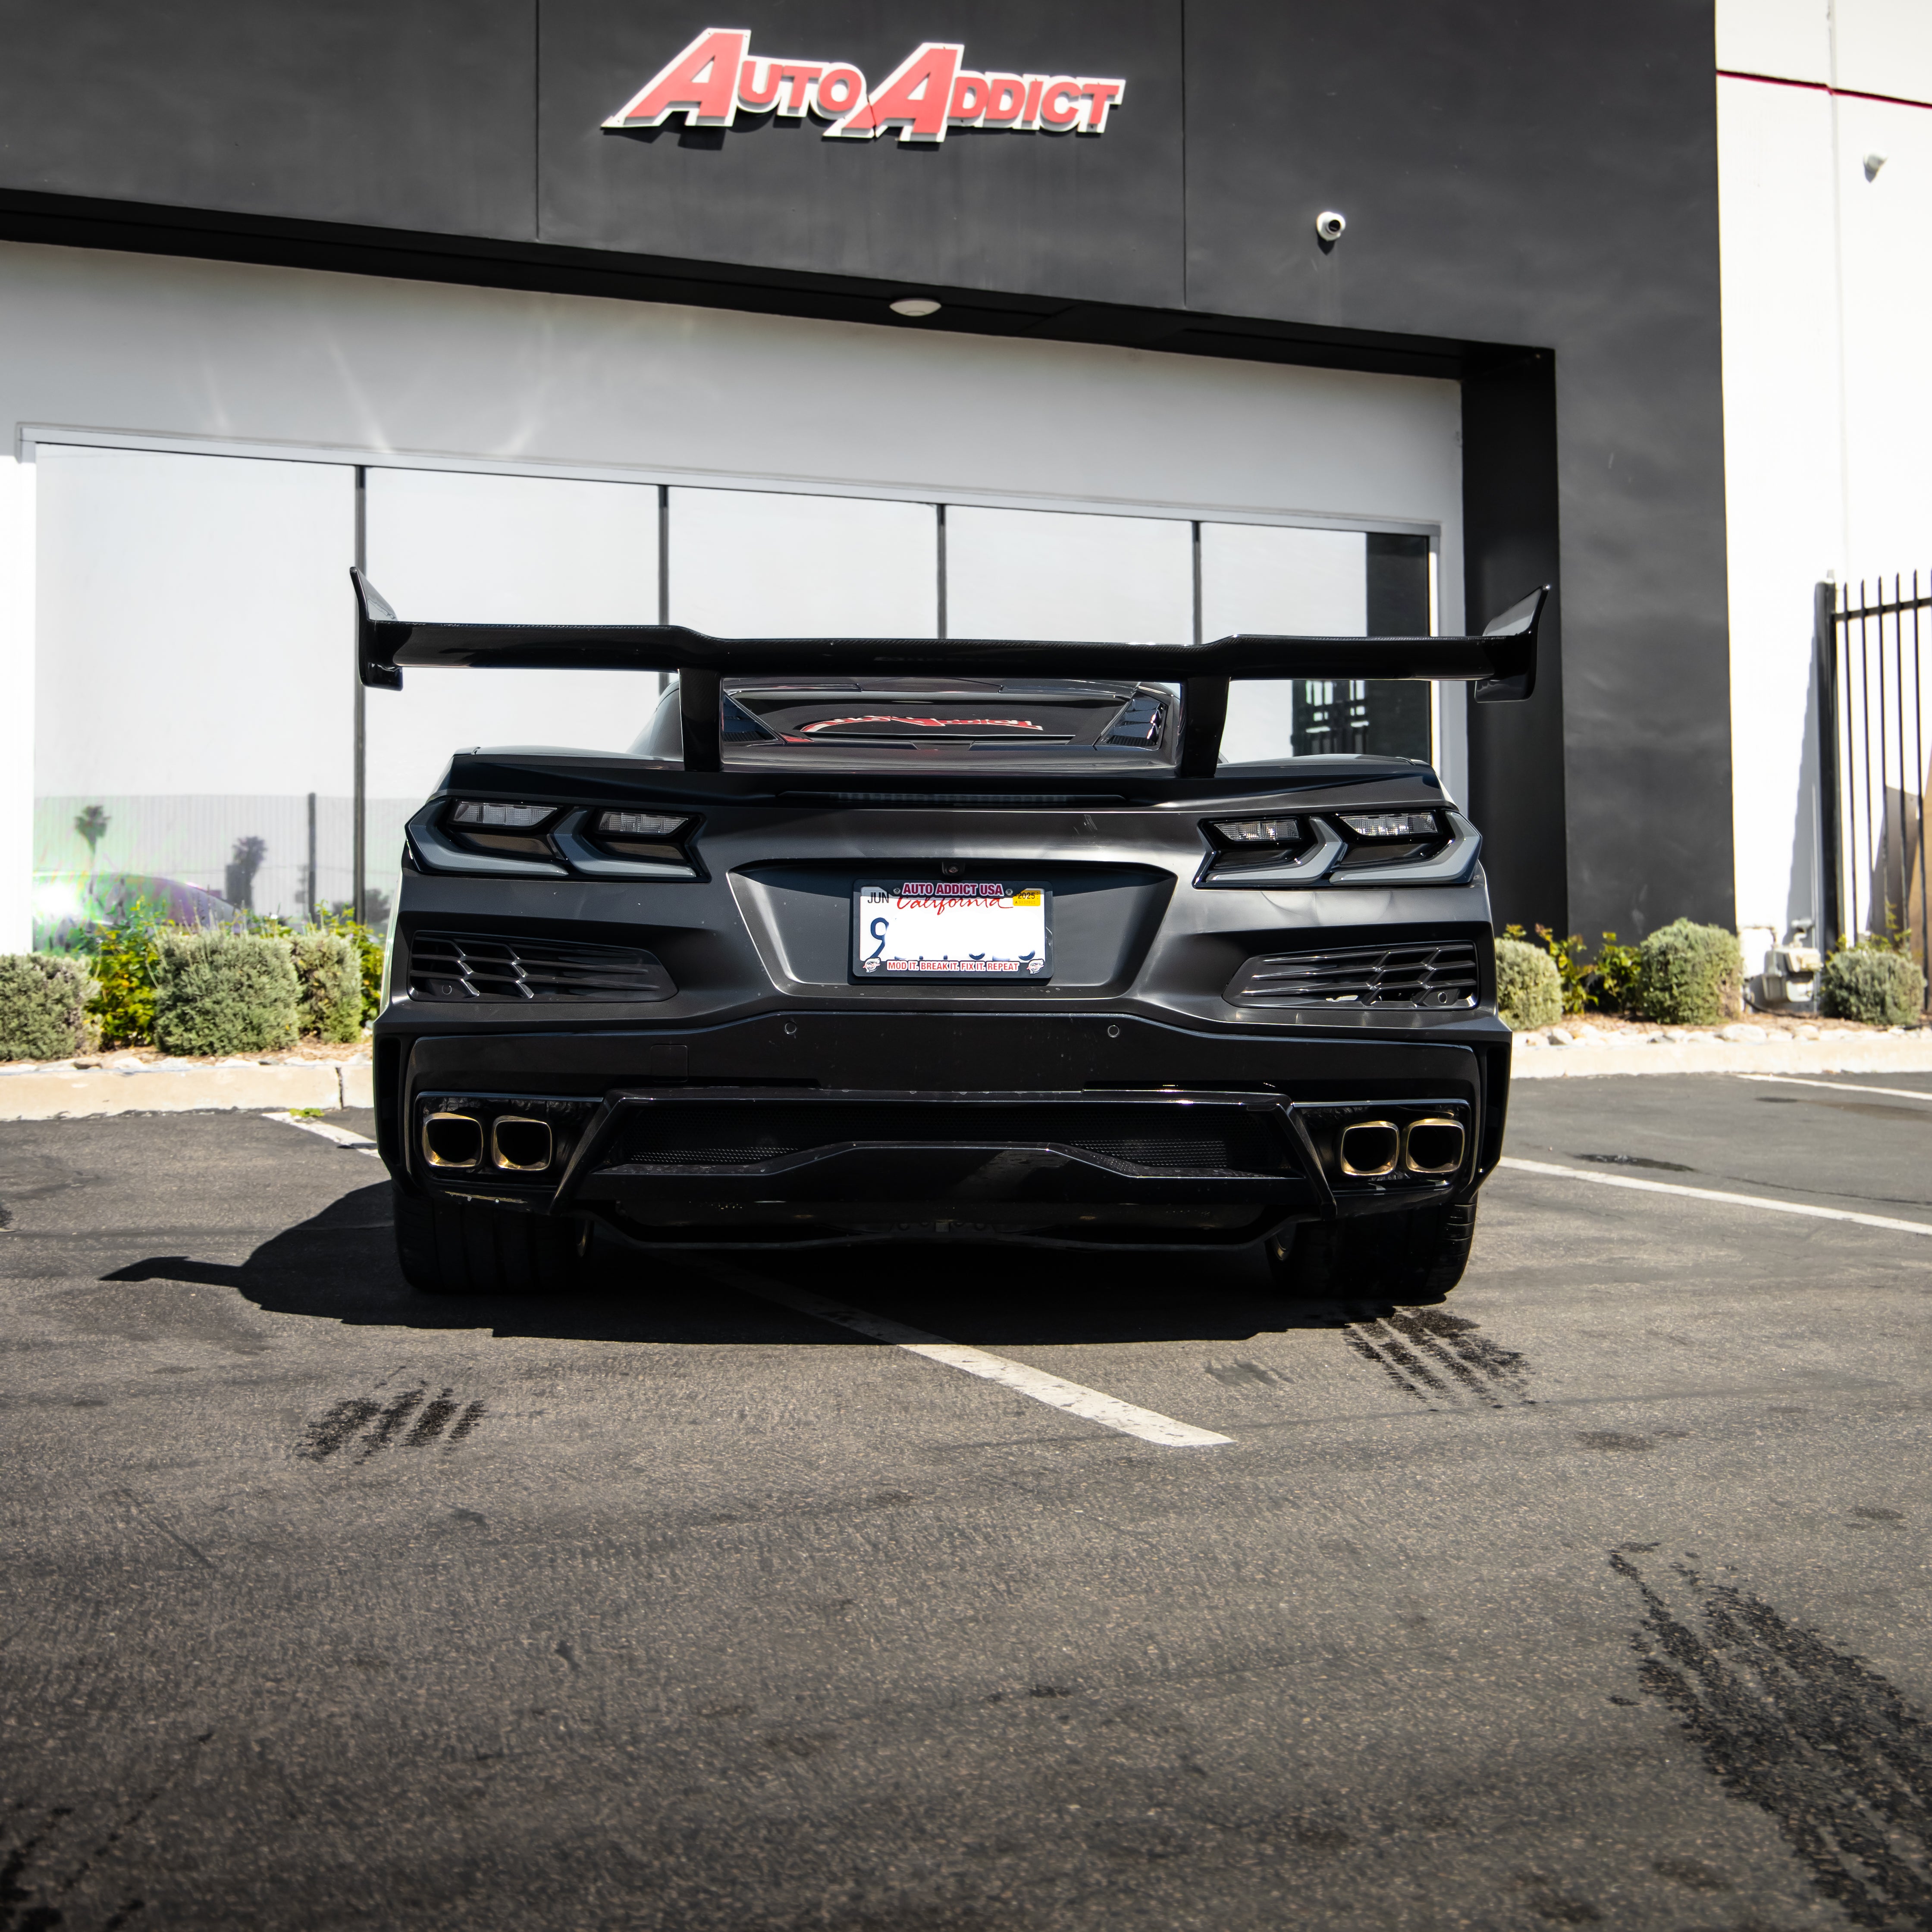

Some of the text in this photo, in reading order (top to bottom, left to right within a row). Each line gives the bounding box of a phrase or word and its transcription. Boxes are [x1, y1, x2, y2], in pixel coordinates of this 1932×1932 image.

[601, 28, 1126, 142] AUTO ADDICT
[902, 883, 1004, 896] AUTO ADDICT USA
[867, 892, 889, 903] JUN
[897, 897, 1013, 915] California
